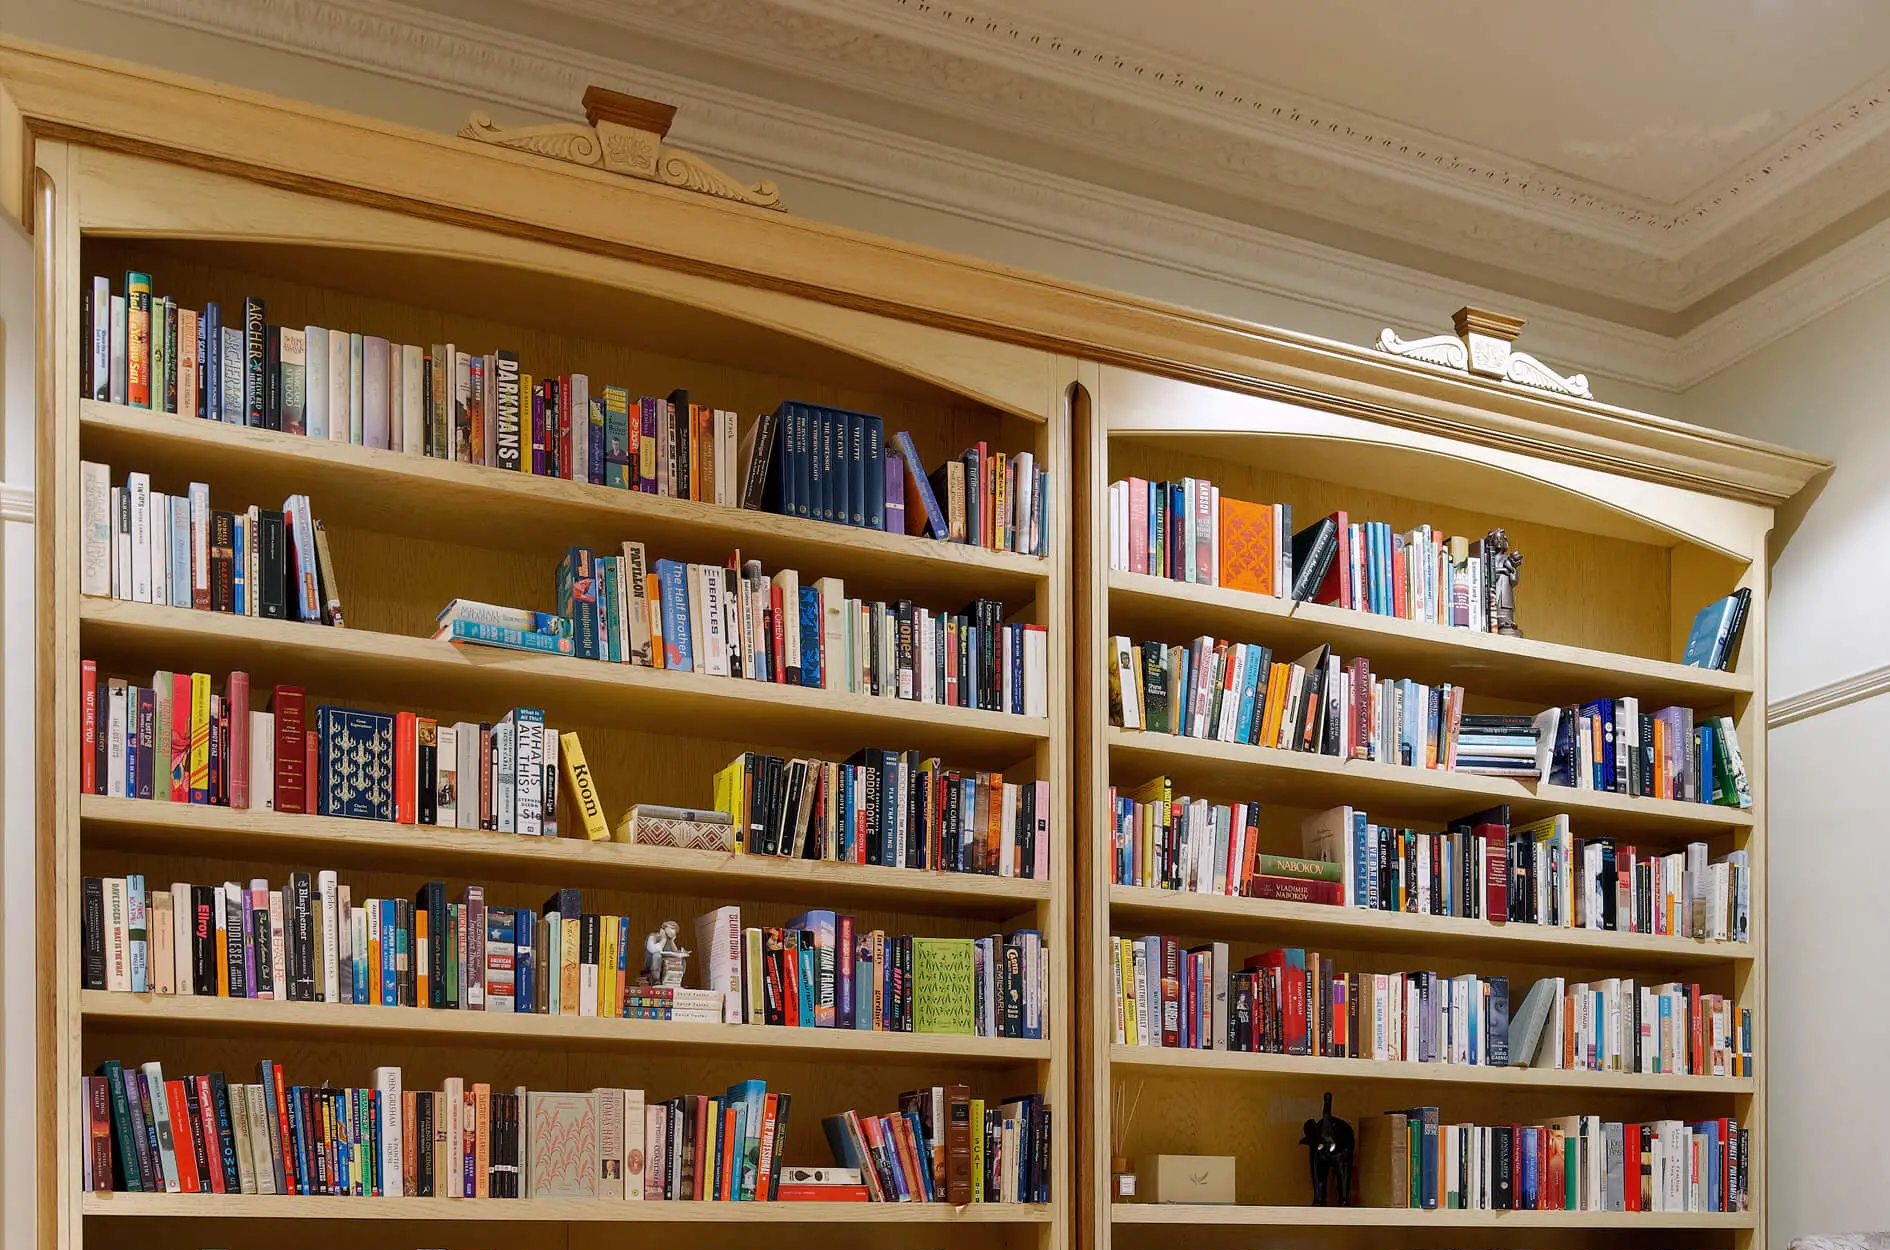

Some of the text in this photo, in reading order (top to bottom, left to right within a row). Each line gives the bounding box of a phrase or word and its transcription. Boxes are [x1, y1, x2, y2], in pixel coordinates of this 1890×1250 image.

[249, 303, 263, 358] ARCHER
[130, 362, 140, 384] Sun
[498, 360, 519, 459] DARKMANS
[1200, 482, 1209, 514] LARSSON
[631, 547, 645, 598] PAPILLON
[673, 564, 689, 657] The Half Brother
[708, 578, 720, 635] BEATLES
[774, 607, 784, 640] COHEN
[86, 691, 94, 706] NOT
[518, 724, 531, 794] ALL THIS?
[530, 724, 542, 786] WHAT IS
[573, 763, 599, 818] Room
[865, 767, 875, 835] RODDY DOYLE
[887, 787, 895, 804] PLAY
[950, 787, 958, 808] SISTER
[886, 828, 894, 850] THING
[1277, 860, 1324, 875] NABOKOV
[197, 904, 210, 938] Ellroy
[296, 888, 310, 941] Blasphemer
[113, 927, 122, 945] WHAT
[115, 962, 123, 977] WHAT
[730, 976, 739, 992] FOX
[894, 968, 903, 994] HAPPY
[874, 989, 884, 1028] gardner
[387, 1072, 397, 1127] JOHN GRISHAM
[760, 1119, 776, 1175] THE PROFESSIONAL
[1729, 1120, 1738, 1203] THE LONELY POLYGAMIST
